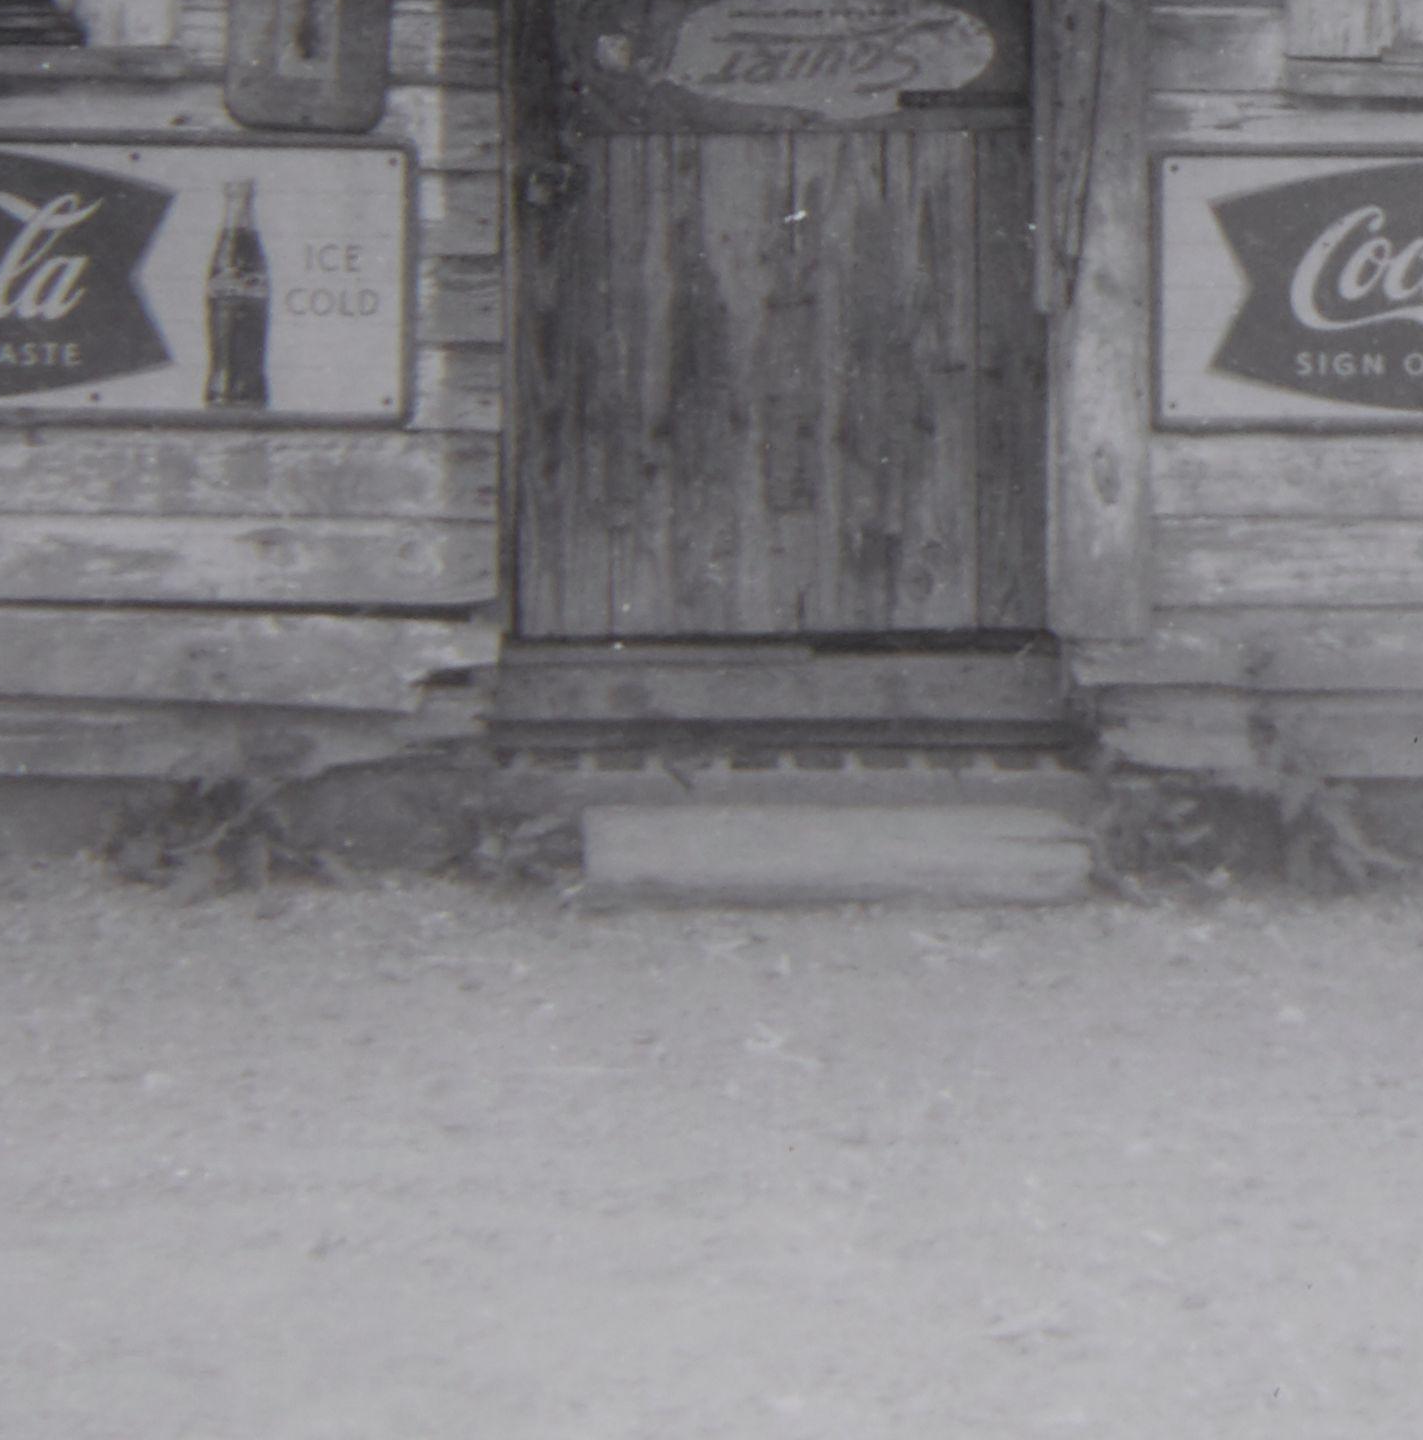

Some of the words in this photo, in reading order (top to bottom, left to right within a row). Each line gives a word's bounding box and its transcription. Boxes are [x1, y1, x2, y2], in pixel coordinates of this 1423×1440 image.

[303, 242, 363, 274] ICE
[286, 286, 381, 318] COLD
[1296, 351, 1384, 376] SIGN
